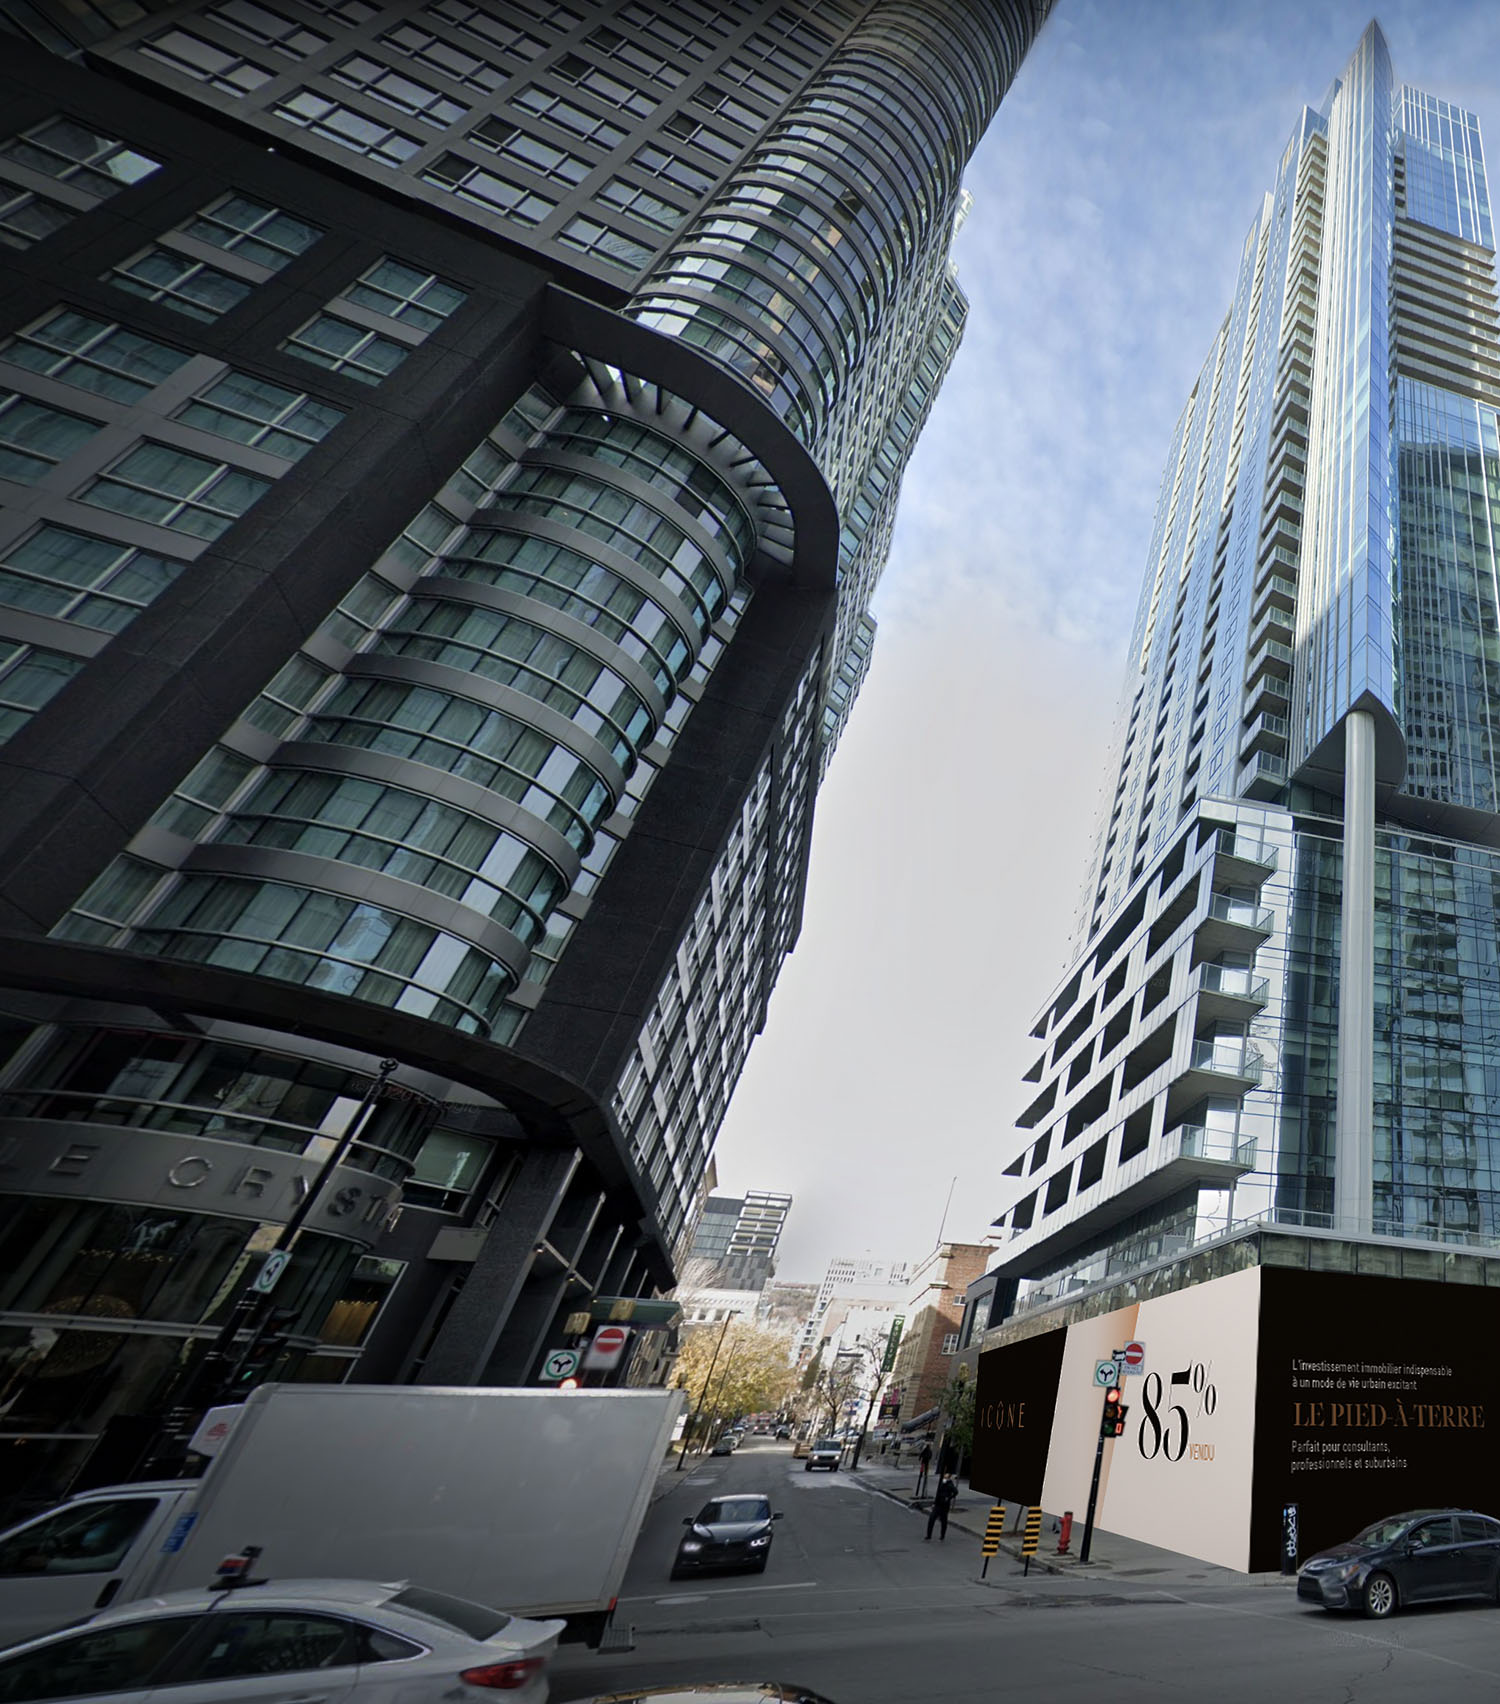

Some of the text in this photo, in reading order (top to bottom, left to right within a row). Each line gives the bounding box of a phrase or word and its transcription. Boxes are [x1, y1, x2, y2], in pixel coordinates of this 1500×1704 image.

[1292, 1359, 1452, 1378] L'investissement immobilier indispensable
[1292, 1375, 1418, 1391] à un mode de vie urbain excitant
[1293, 1398, 1486, 1428] LE PIED-À-TERRE
[1189, 1444, 1215, 1461] VENDU
[1291, 1440, 1390, 1454] Parfait pour consultants,
[1290, 1456, 1408, 1474] professionnels et suburbains
